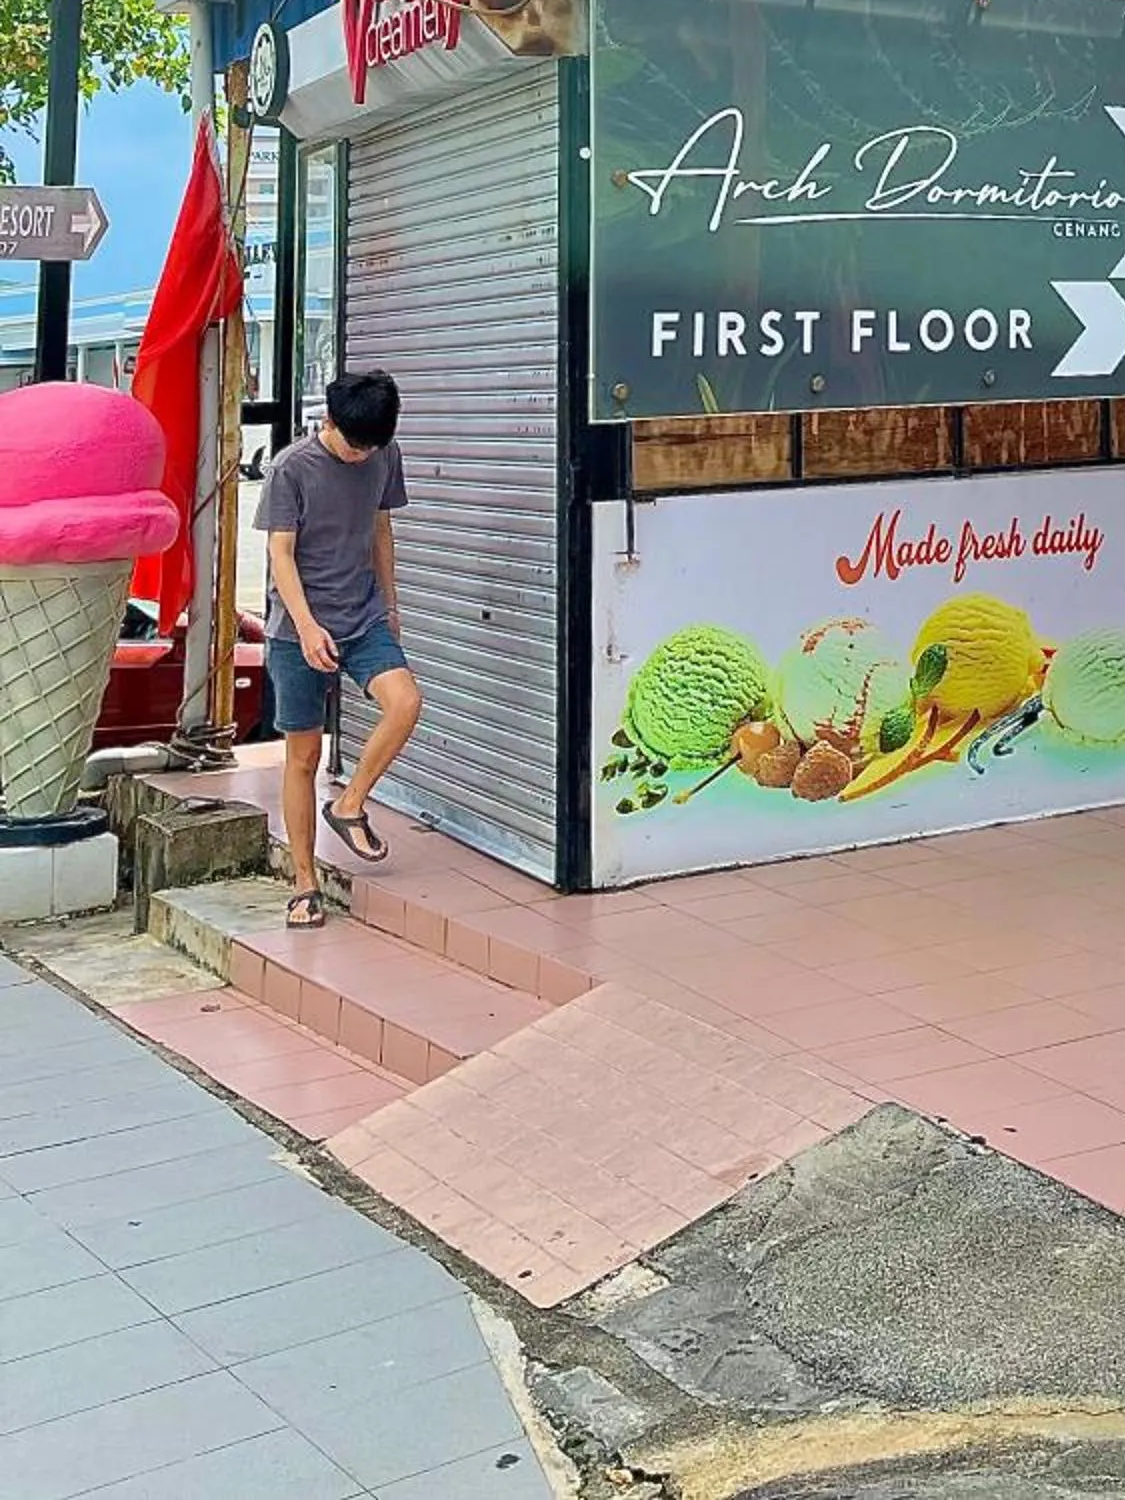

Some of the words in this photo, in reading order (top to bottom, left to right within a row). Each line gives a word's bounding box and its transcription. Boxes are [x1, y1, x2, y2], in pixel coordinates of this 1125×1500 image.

[628, 107, 832, 232] Arch
[1053, 222, 1122, 238] CENANG
[650, 310, 820, 357] FIRST
[851, 308, 1033, 354] FLOOR
[835, 509, 952, 585] Made
[952, 516, 1027, 583] fresh
[1032, 512, 1104, 570] daily
